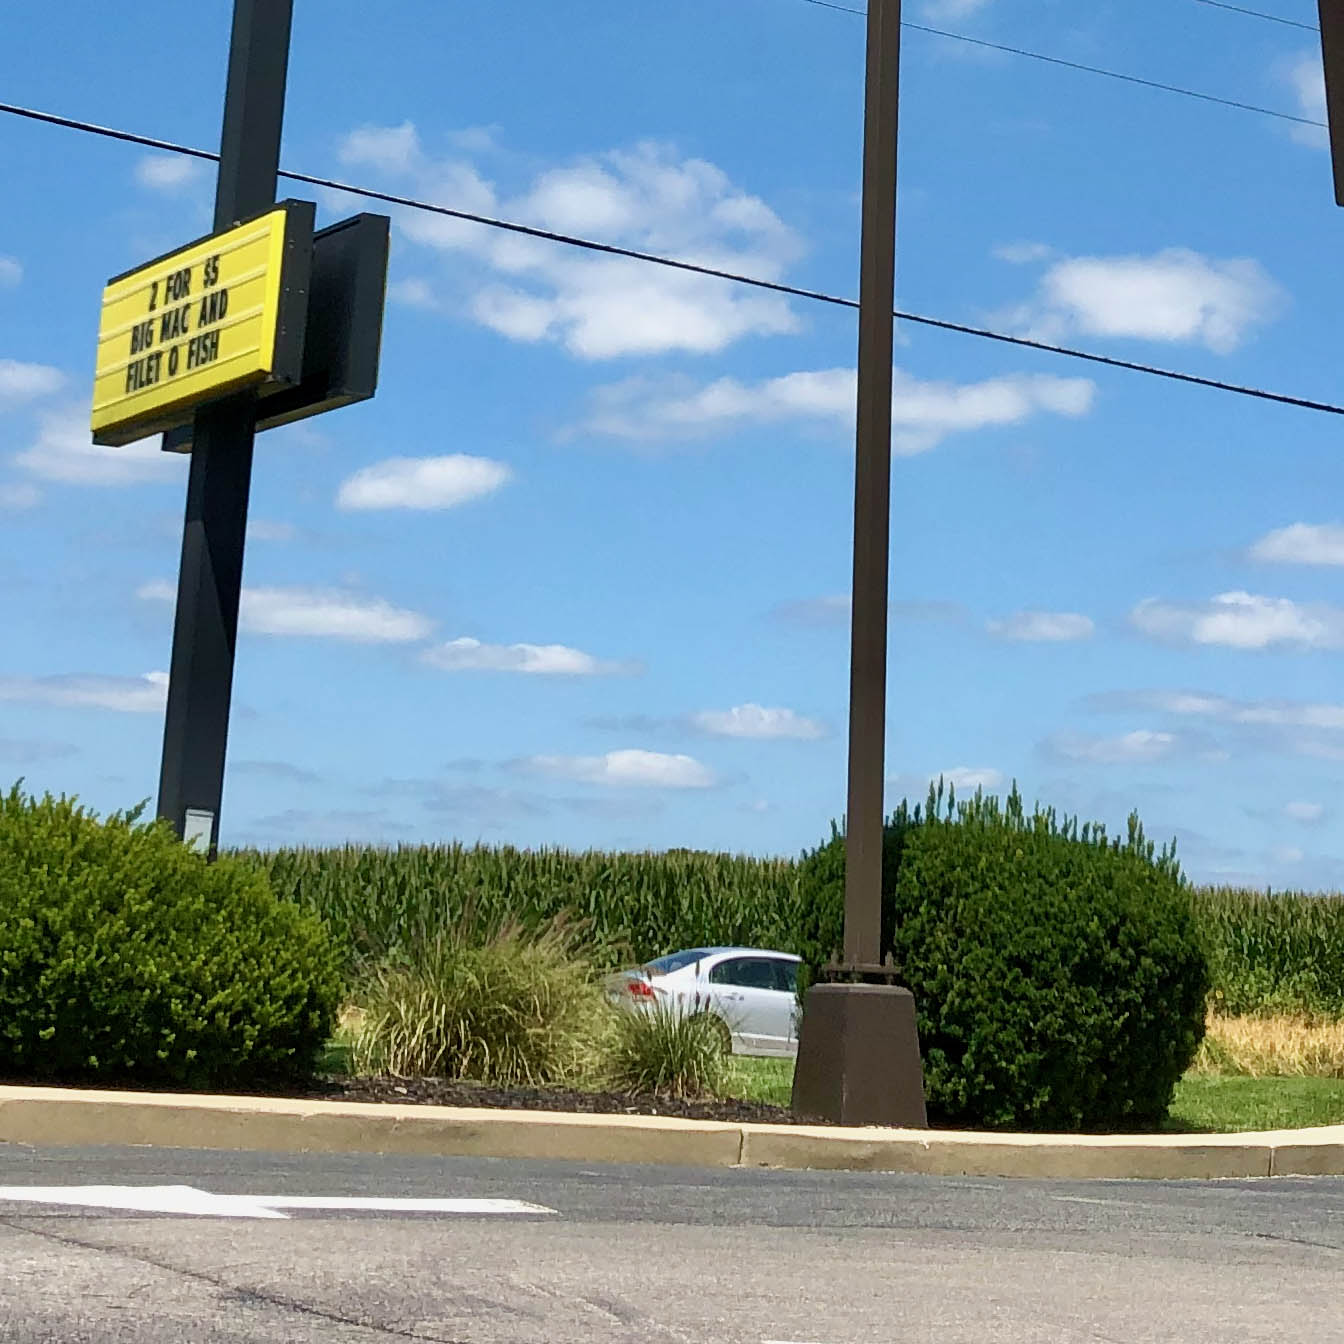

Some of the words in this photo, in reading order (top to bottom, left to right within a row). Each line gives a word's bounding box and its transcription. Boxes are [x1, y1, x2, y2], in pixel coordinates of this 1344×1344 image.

[164, 267, 192, 305] FOR
[130, 319, 155, 355] BIG
[159, 304, 192, 343] MAC
[197, 287, 229, 328] AND
[125, 350, 163, 394] FILET
[187, 330, 220, 370] FISH
